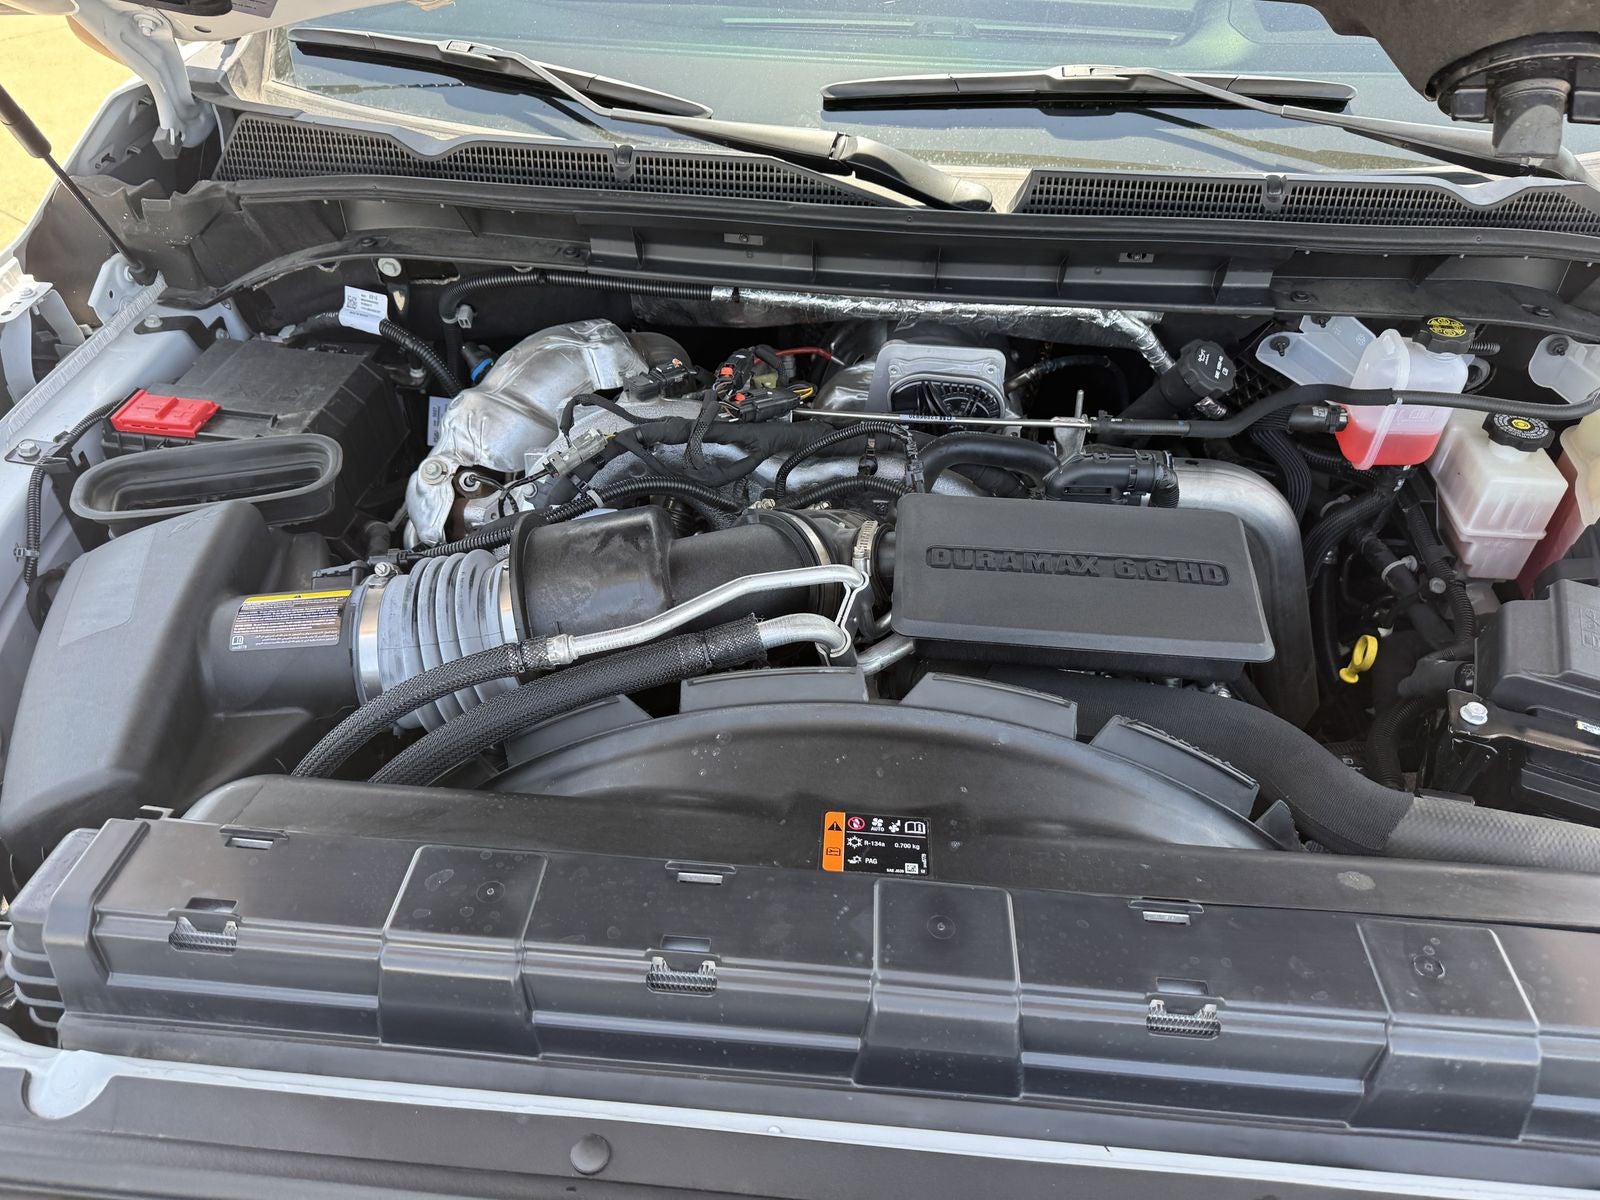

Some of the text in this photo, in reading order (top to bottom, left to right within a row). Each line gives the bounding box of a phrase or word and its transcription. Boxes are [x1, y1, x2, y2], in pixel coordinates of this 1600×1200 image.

[930, 547, 1227, 585] DURAMAX 6.6 HD
[894, 842, 912, 850] 0.700
